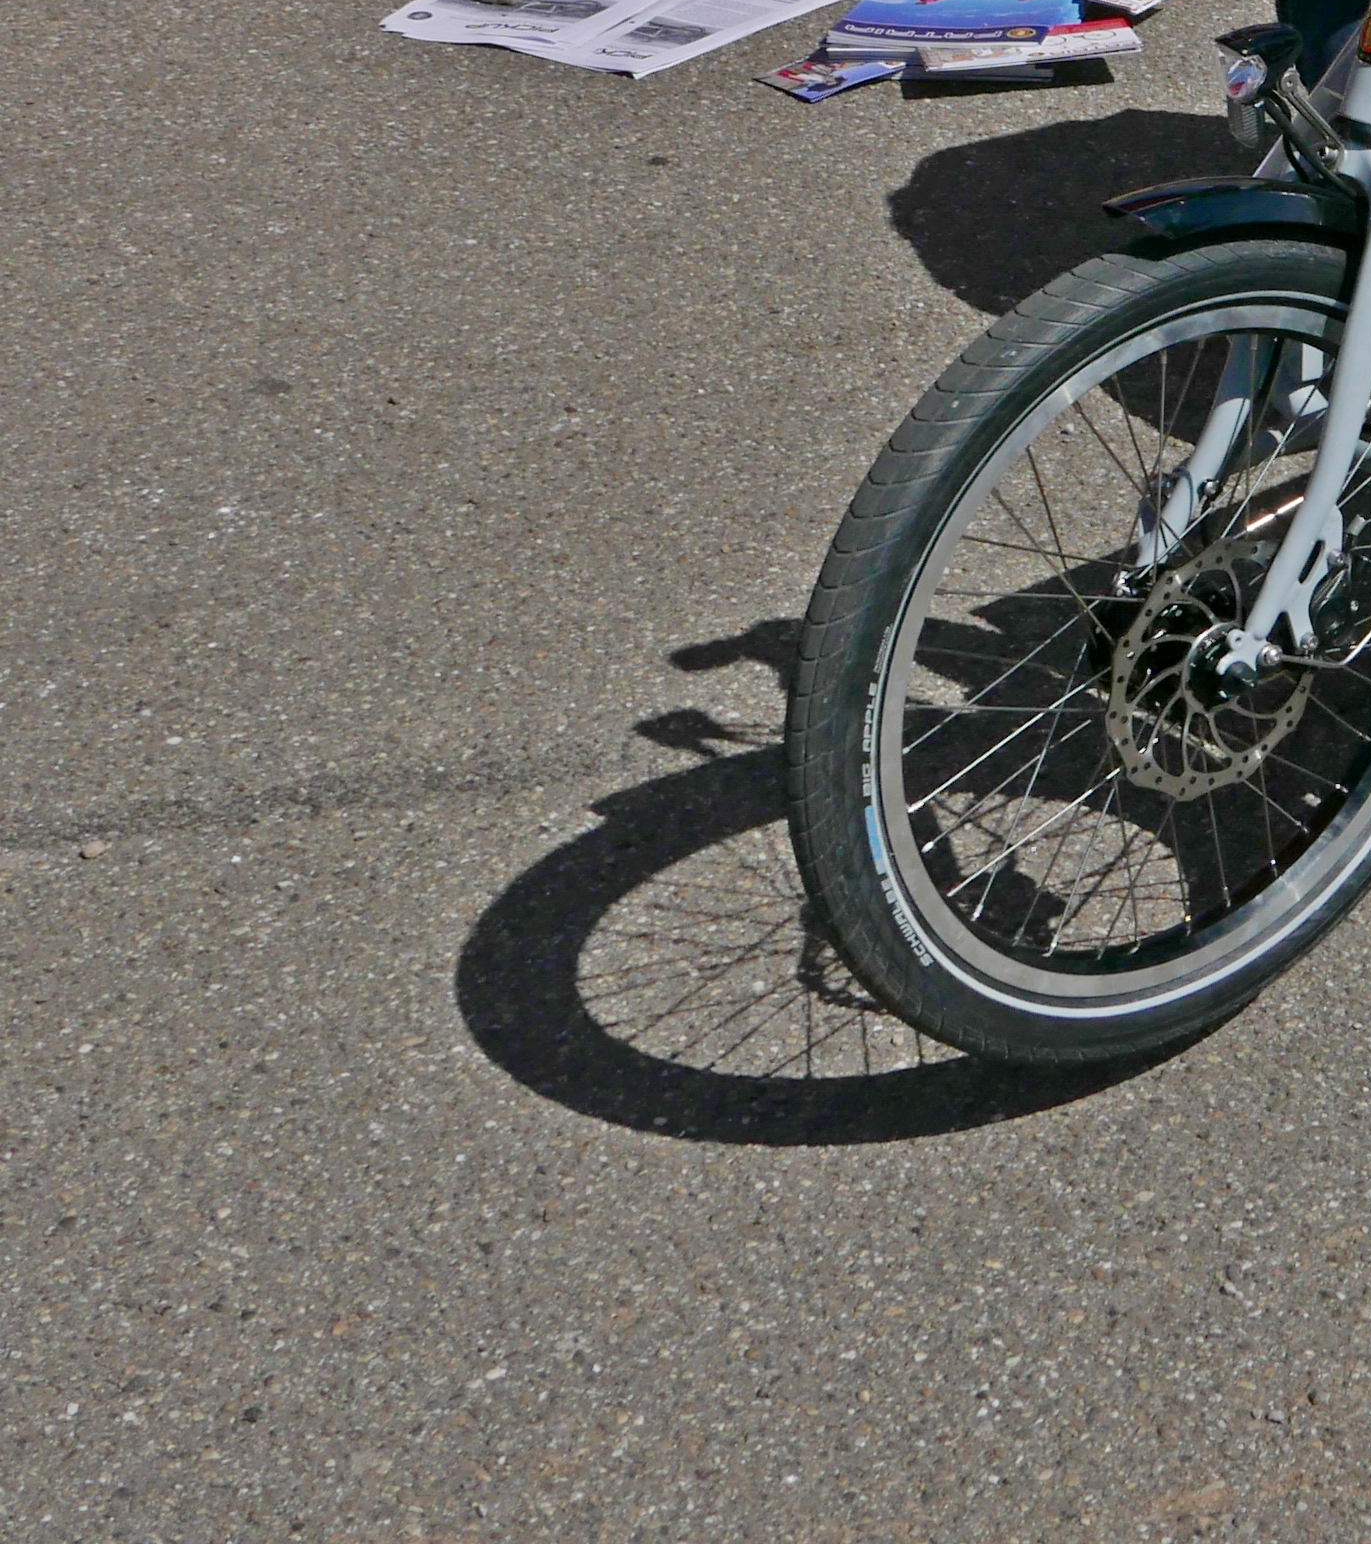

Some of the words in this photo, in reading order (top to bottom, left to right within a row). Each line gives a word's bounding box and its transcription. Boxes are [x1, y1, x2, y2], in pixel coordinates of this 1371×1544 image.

[465, 23, 560, 33] PICKUP
[844, 23, 1004, 40] PATRIA
[594, 47, 654, 60] PICK
[862, 763, 872, 798] BIG
[880, 877, 935, 968] SCHWALBE
